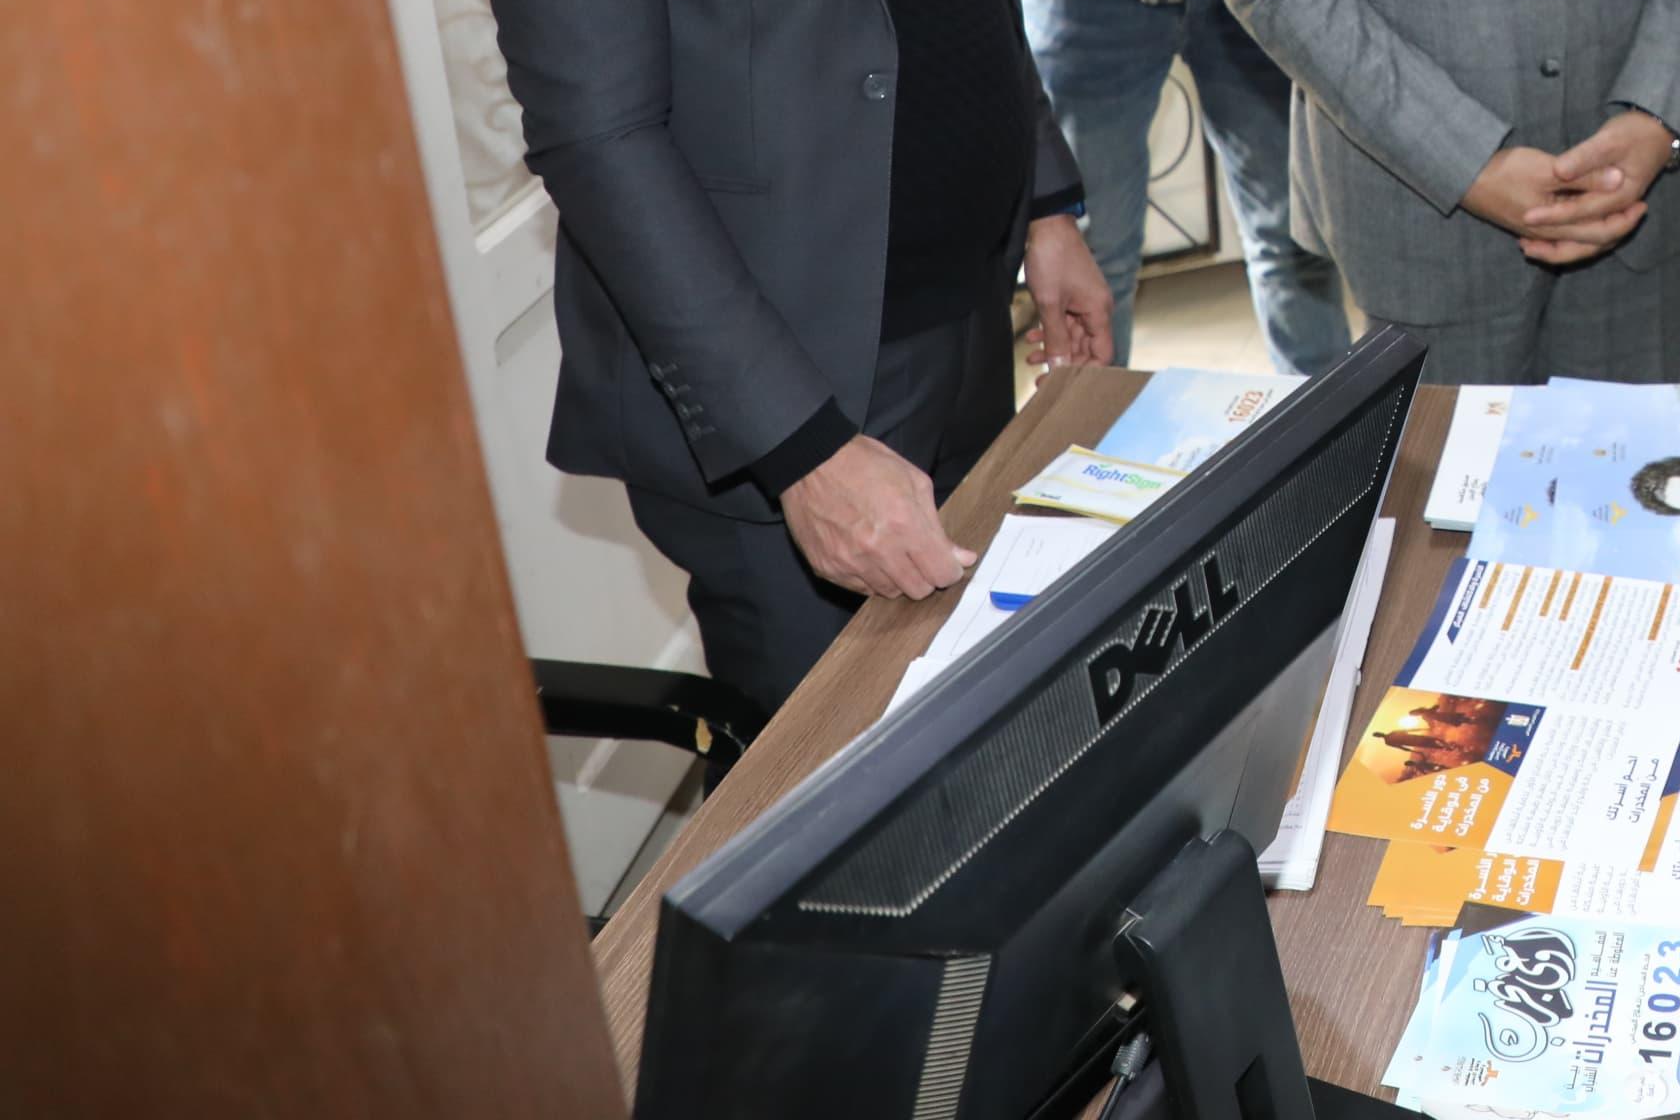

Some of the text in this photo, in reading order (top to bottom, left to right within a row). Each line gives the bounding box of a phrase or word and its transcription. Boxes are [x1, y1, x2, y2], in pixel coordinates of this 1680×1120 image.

[1088, 554, 1240, 726] DELL
[1455, 793, 1483, 837] المخدرات
[1628, 758, 1660, 824] من المخدرات
[1573, 980, 1619, 1064] المخدرات
